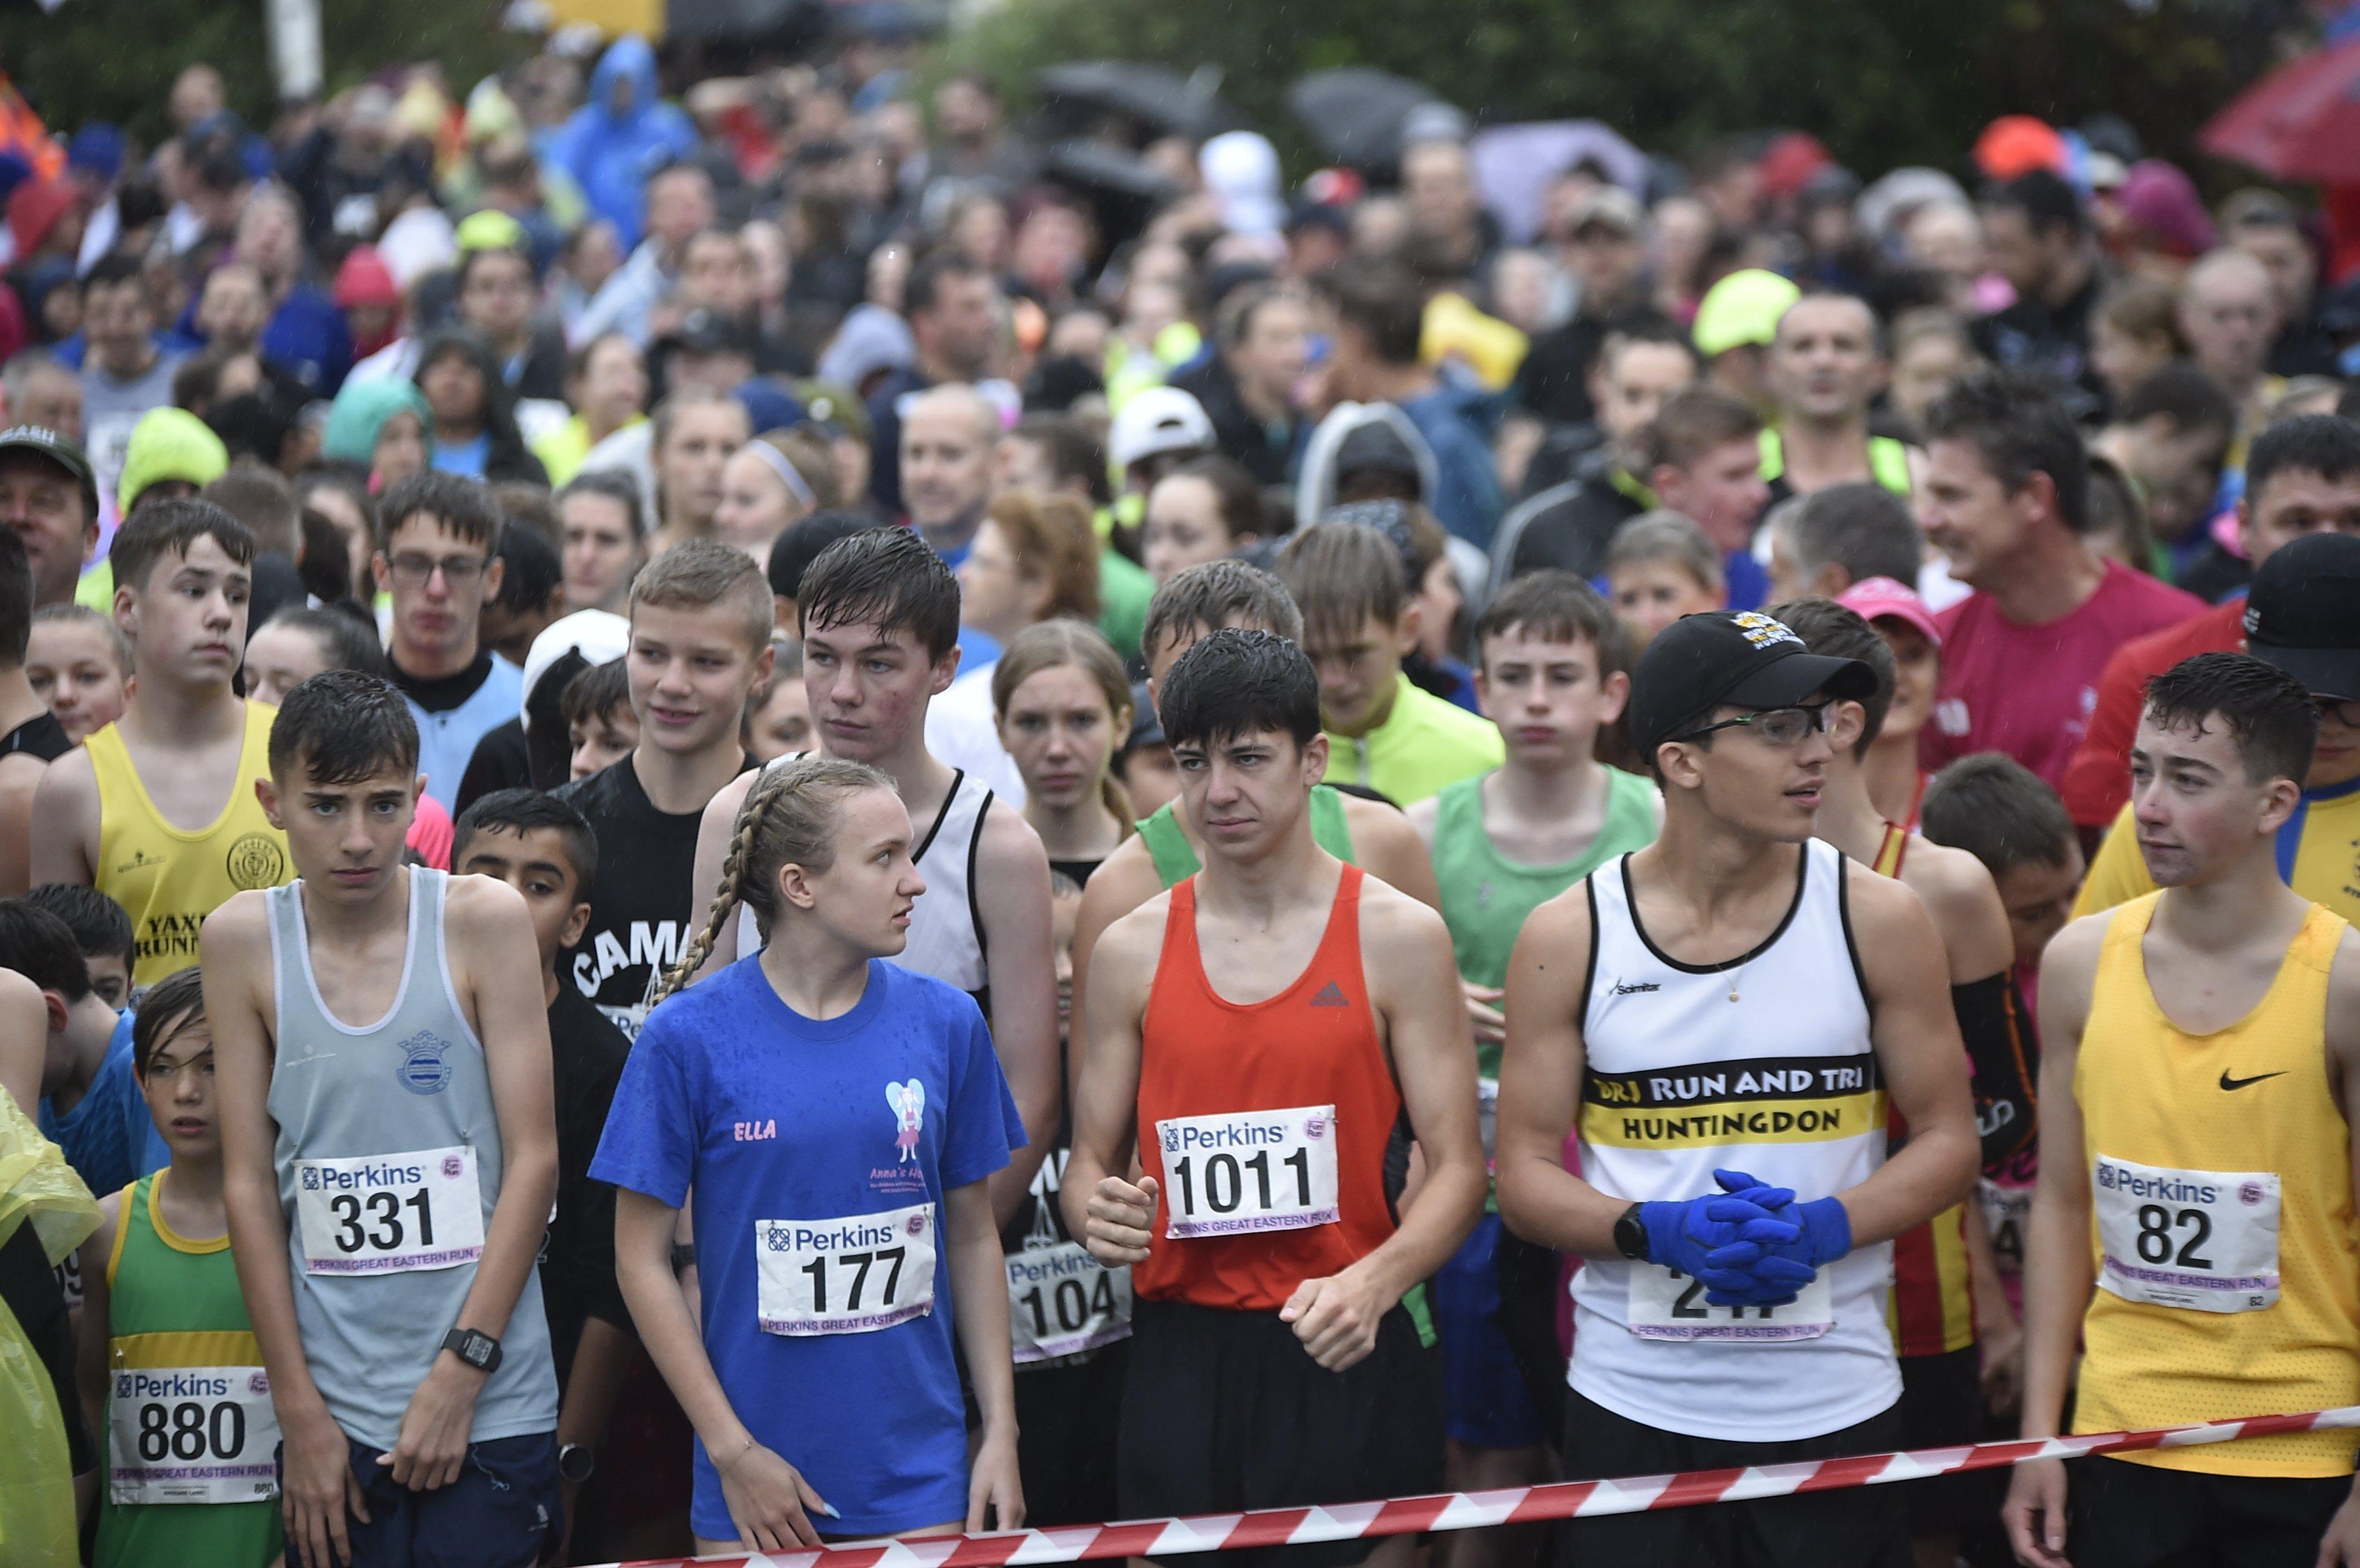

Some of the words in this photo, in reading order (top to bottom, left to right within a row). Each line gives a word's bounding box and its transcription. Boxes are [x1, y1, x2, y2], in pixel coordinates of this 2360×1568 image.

[1649, 1074, 1727, 1101] RUN
[1734, 1070, 1813, 1094] AND
[1820, 1067, 1863, 1090] TRI
[734, 1119, 776, 1142] ELLA
[1183, 1122, 1283, 1150] Perkins
[1622, 1108, 1840, 1140] HUNTINGDON
[322, 1164, 421, 1189] Perkins
[1174, 1147, 1311, 1216] 1011
[2117, 1168, 2216, 1204] Perkins
[331, 1187, 434, 1253] 331
[1213, 1220, 1250, 1232] GREAT
[1254, 1215, 1308, 1228] EASTERN
[796, 1225, 892, 1251] Perkins
[2137, 1204, 2213, 1270] 82
[313, 1260, 350, 1270] PERKINS
[352, 1258, 389, 1269] GREAT
[393, 1253, 446, 1267] EASTERN
[450, 1249, 474, 1260] RUN
[802, 1246, 905, 1313] 177
[2140, 1270, 2175, 1283] GREAT
[2180, 1273, 2235, 1288] EASTERN
[2240, 1277, 2266, 1288] RUN
[1021, 1270, 1117, 1337] 104
[2250, 1296, 2265, 1306] 82
[769, 1320, 819, 1331] PERKINS
[821, 1319, 859, 1331] GREAT
[1638, 1326, 1689, 1337] PERKINS
[1693, 1327, 1731, 1338] GREAT
[1736, 1327, 1790, 1337] EASTERN
[1795, 1325, 1820, 1336] RUN
[135, 1375, 227, 1398] Perkins
[139, 1401, 245, 1461] 880
[191, 1466, 244, 1478] EASTERN
[248, 1465, 273, 1476] RUN
